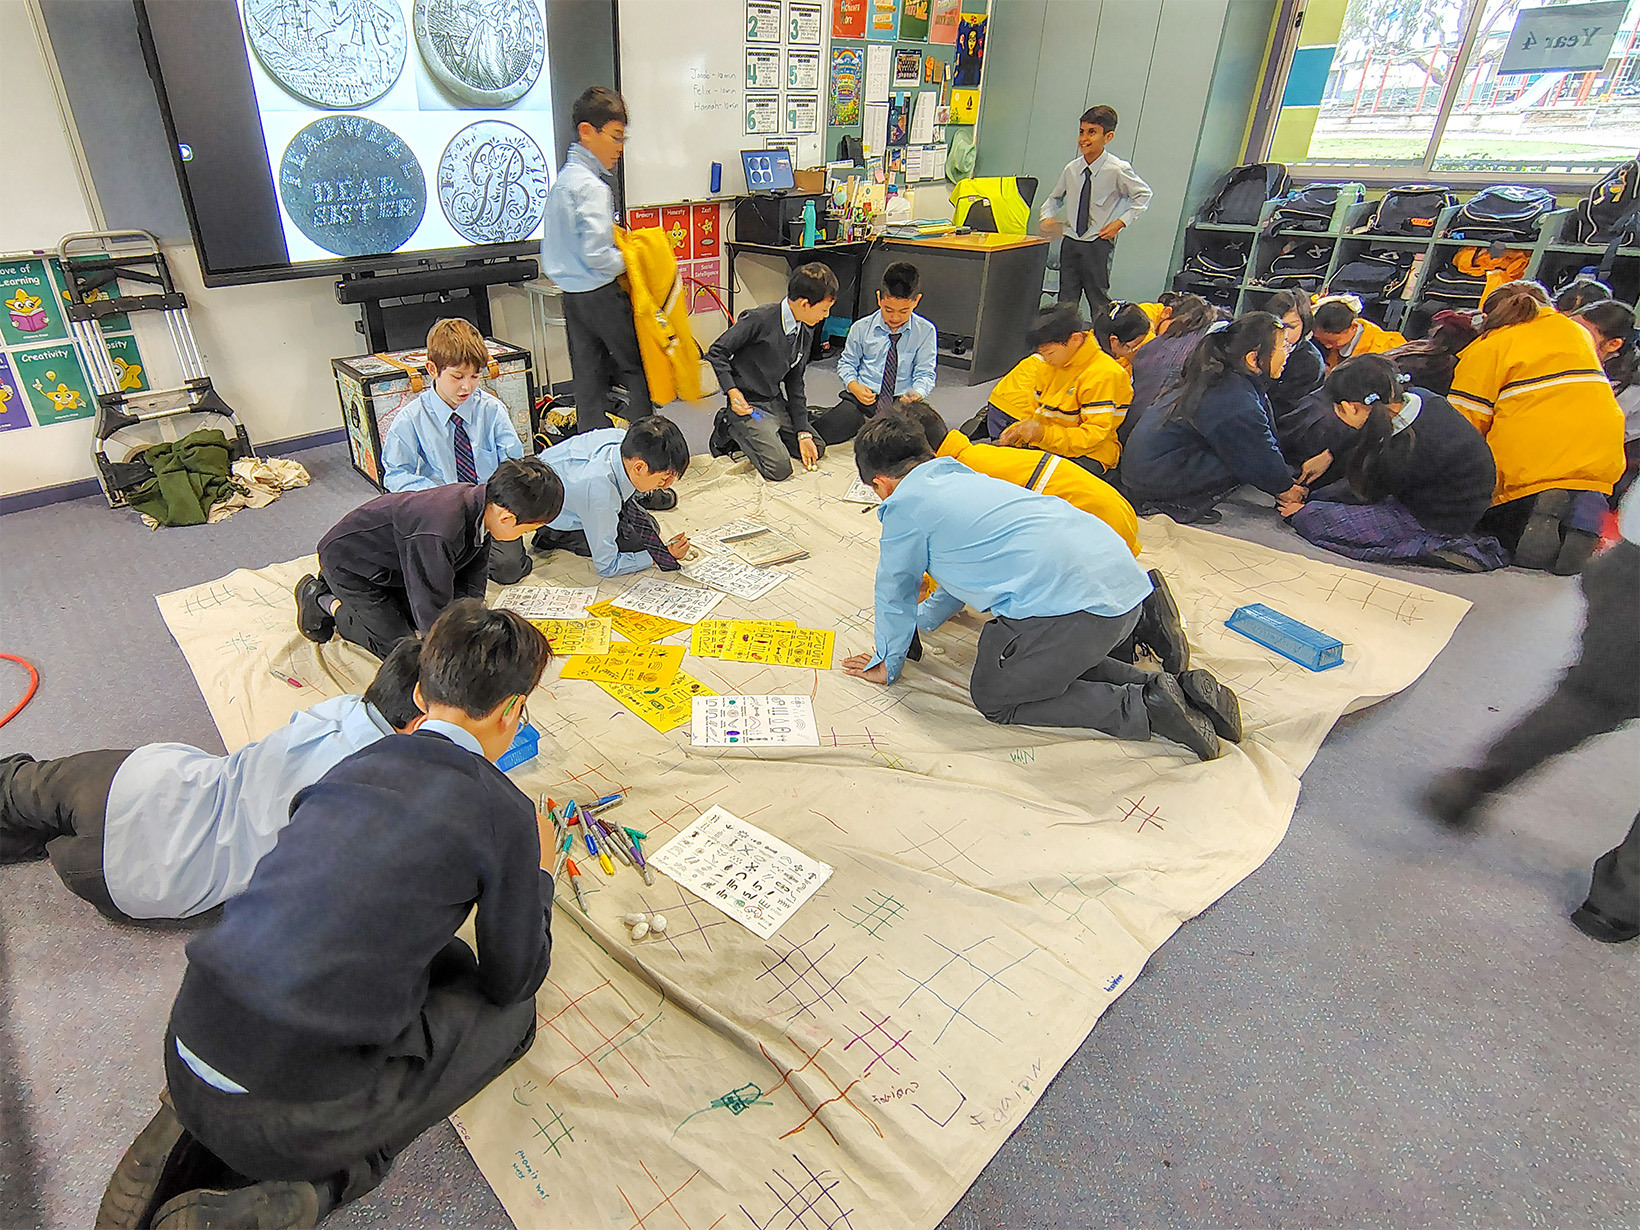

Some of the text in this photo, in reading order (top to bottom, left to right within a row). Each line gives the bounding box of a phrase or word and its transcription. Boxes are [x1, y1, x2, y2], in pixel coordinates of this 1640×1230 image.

[748, 15, 758, 37] 2
[790, 18, 798, 40] 3
[748, 64, 757, 85] 4
[789, 65, 797, 85] 5
[748, 110, 756, 130] 6
[788, 110, 796, 129] 9
[312, 176, 402, 203] DEAR
[312, 197, 416, 228] SISTER
[0, 264, 31, 275] ove of
[21, 349, 69, 363] Creativity
